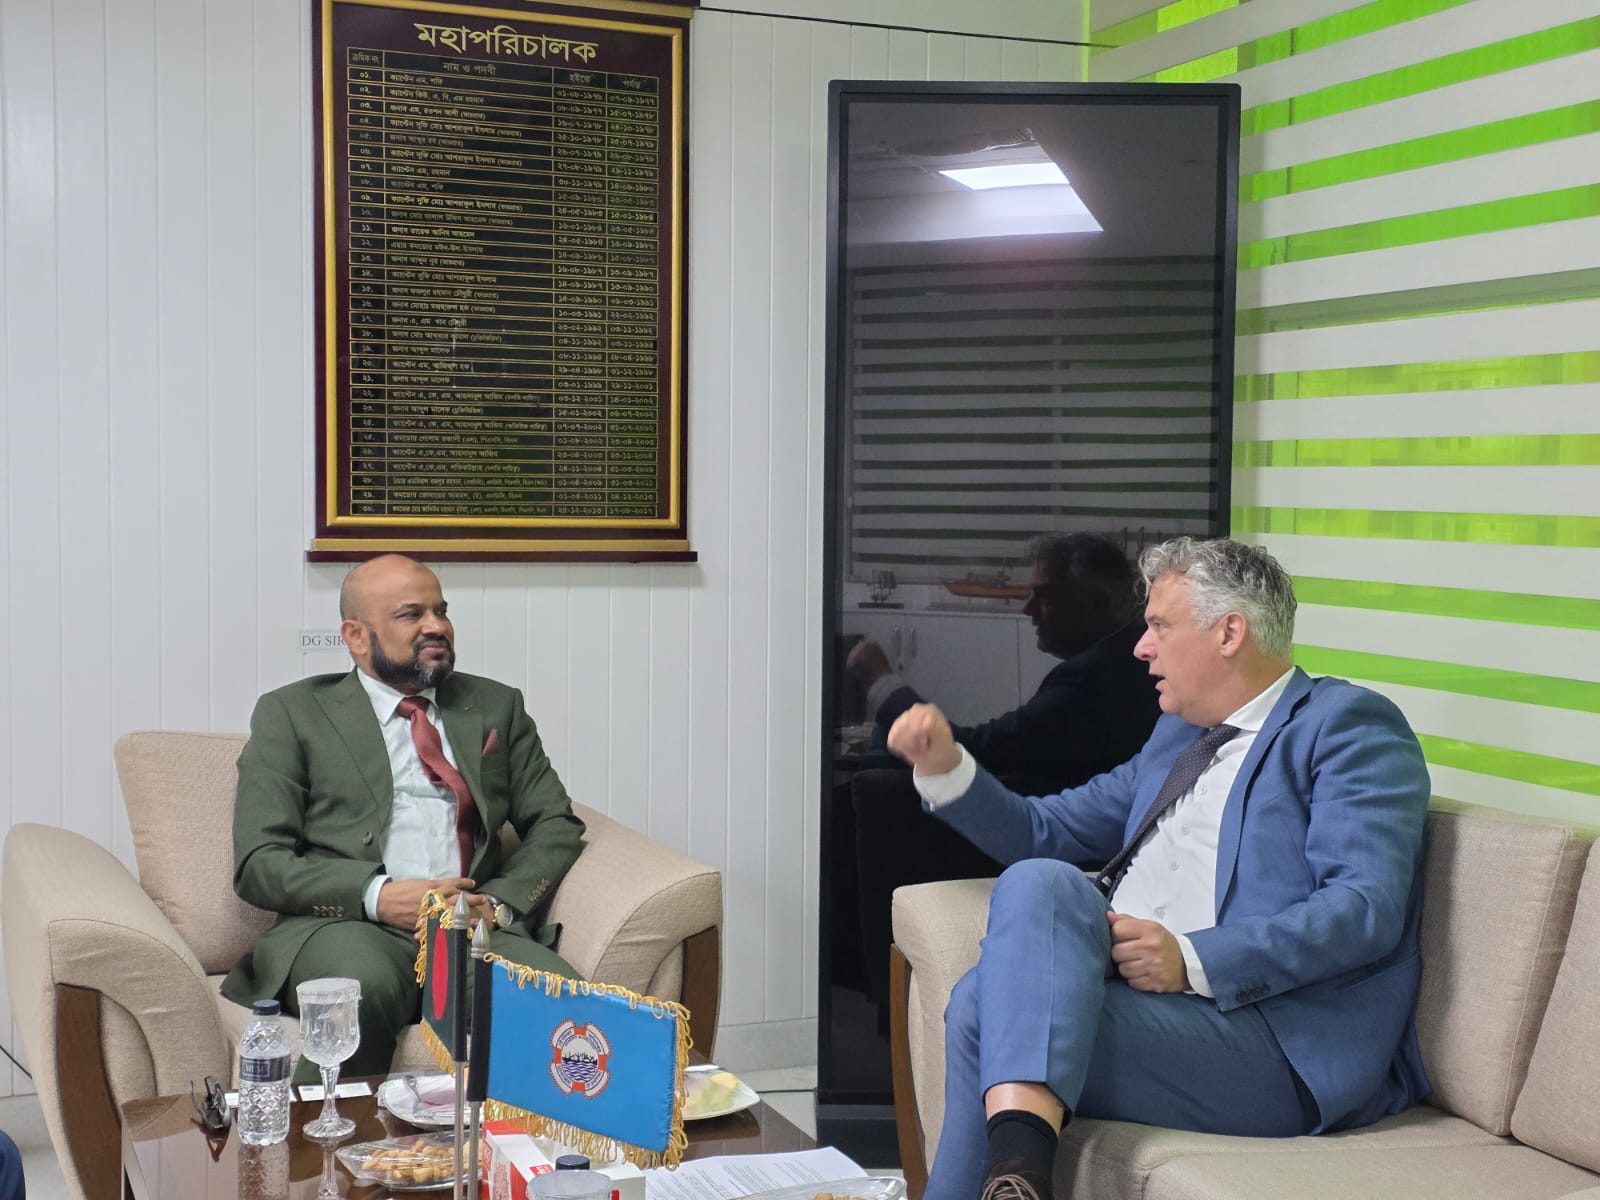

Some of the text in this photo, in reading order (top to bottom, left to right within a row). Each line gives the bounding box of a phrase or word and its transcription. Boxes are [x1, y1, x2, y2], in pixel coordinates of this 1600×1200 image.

[413, 23, 599, 64] মহাপরিচালক
[442, 60, 459, 72] নাম
[302, 635, 321, 647] DG
